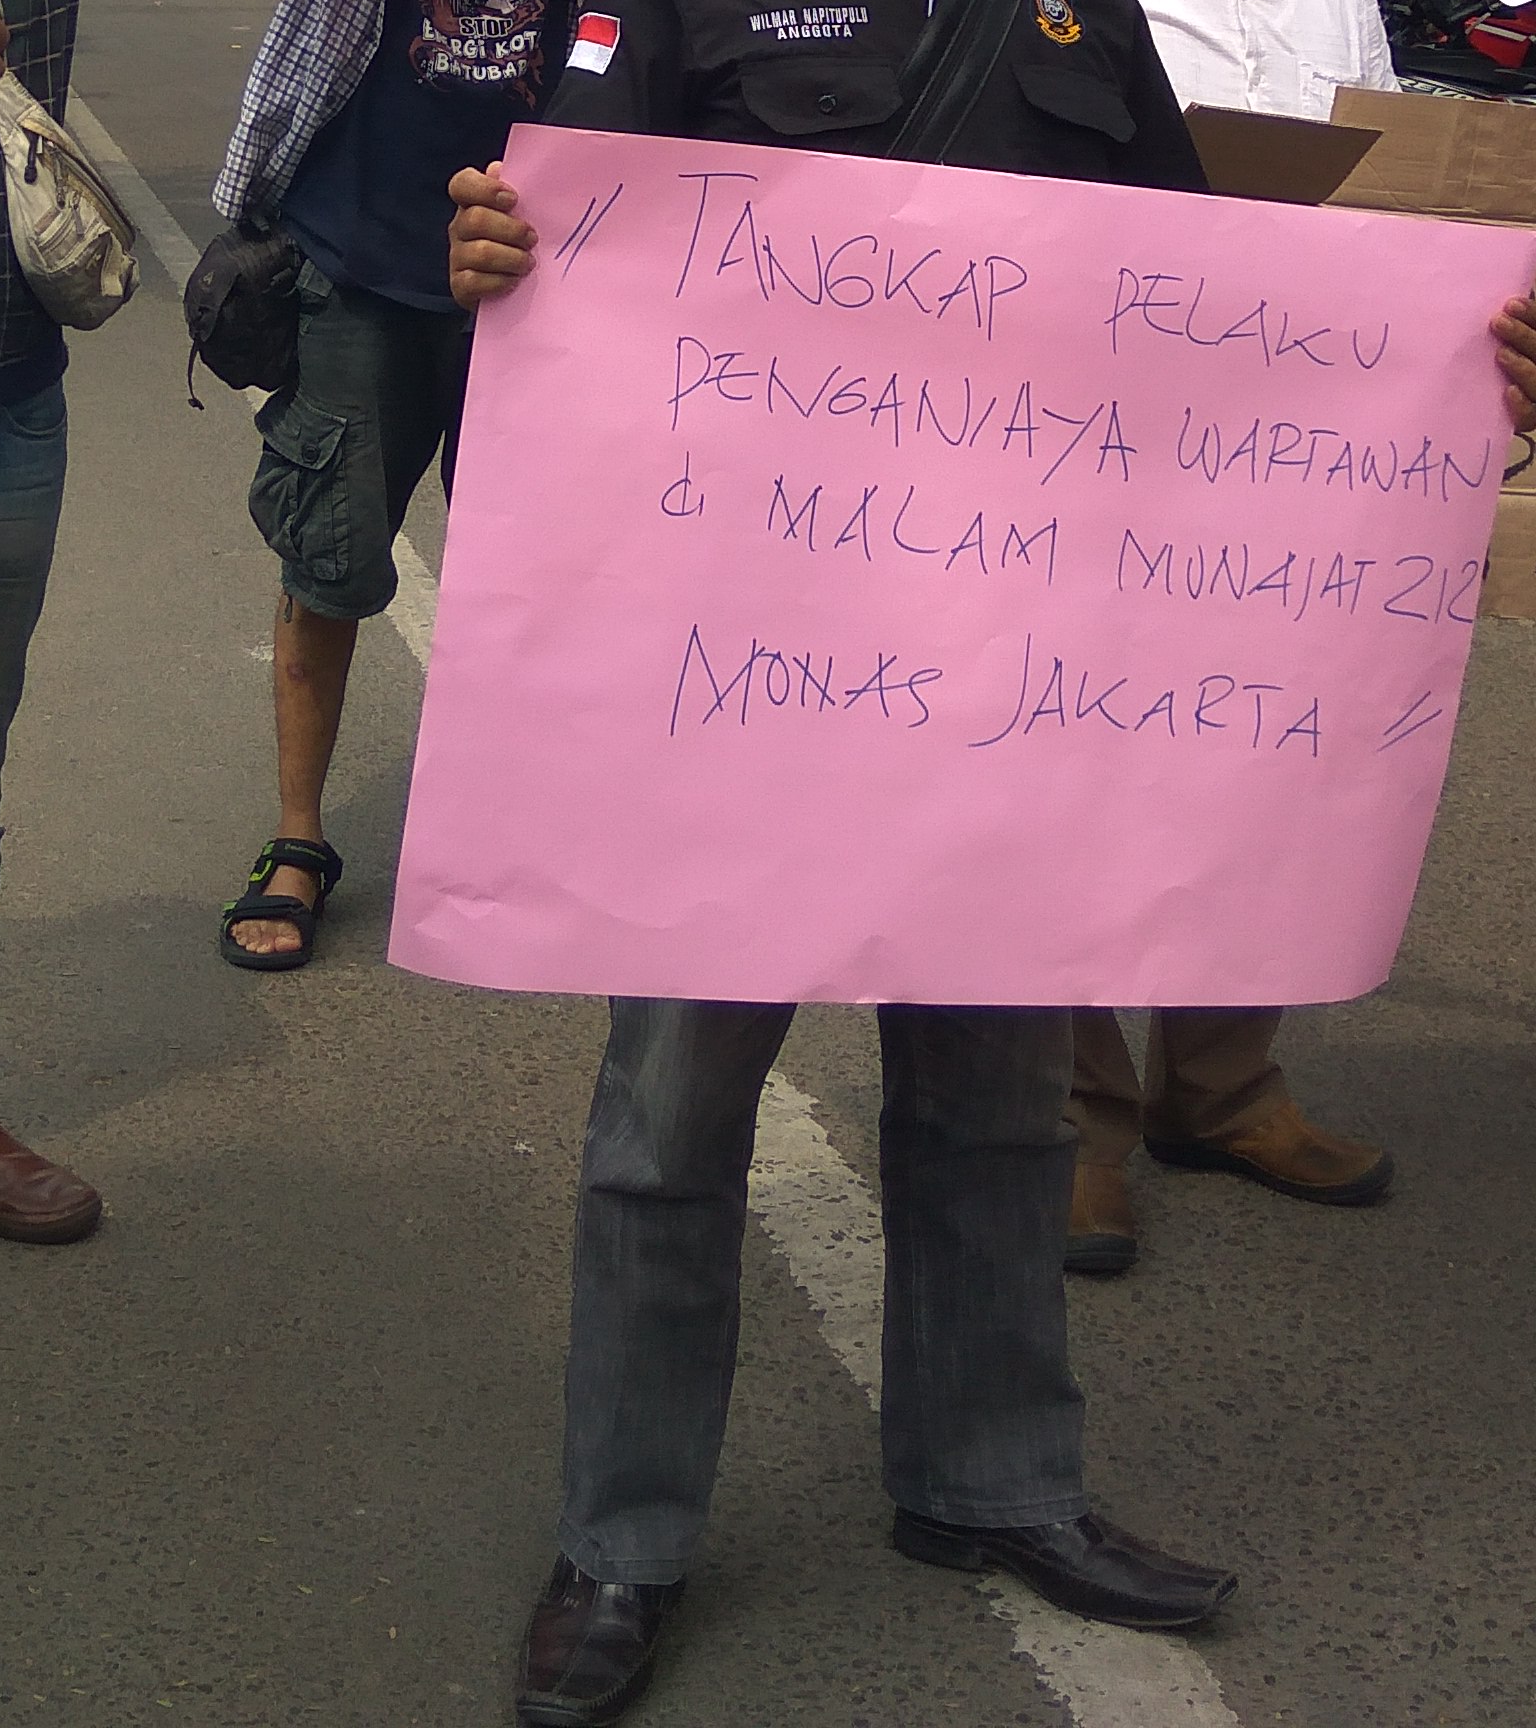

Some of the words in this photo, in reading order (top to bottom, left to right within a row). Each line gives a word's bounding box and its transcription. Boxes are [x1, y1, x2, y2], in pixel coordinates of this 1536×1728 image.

[459, 17, 513, 36] STOP
[496, 31, 541, 58] KOT
[749, 9, 797, 32] WILMAR
[803, 7, 868, 24] NAPITUPULU
[777, 24, 853, 40] ANGGOTA
[674, 173, 1028, 342] TANGKAP
[1105, 266, 1390, 370] PELAKU
[1175, 407, 1491, 502] WARTAWAN
[768, 474, 1057, 585] MALAM
[1118, 528, 1377, 623] MUNAJAT
[1383, 555, 1478, 623] 212
[669, 623, 944, 735] MONAS
[969, 632, 1324, 757] JAKARTA
